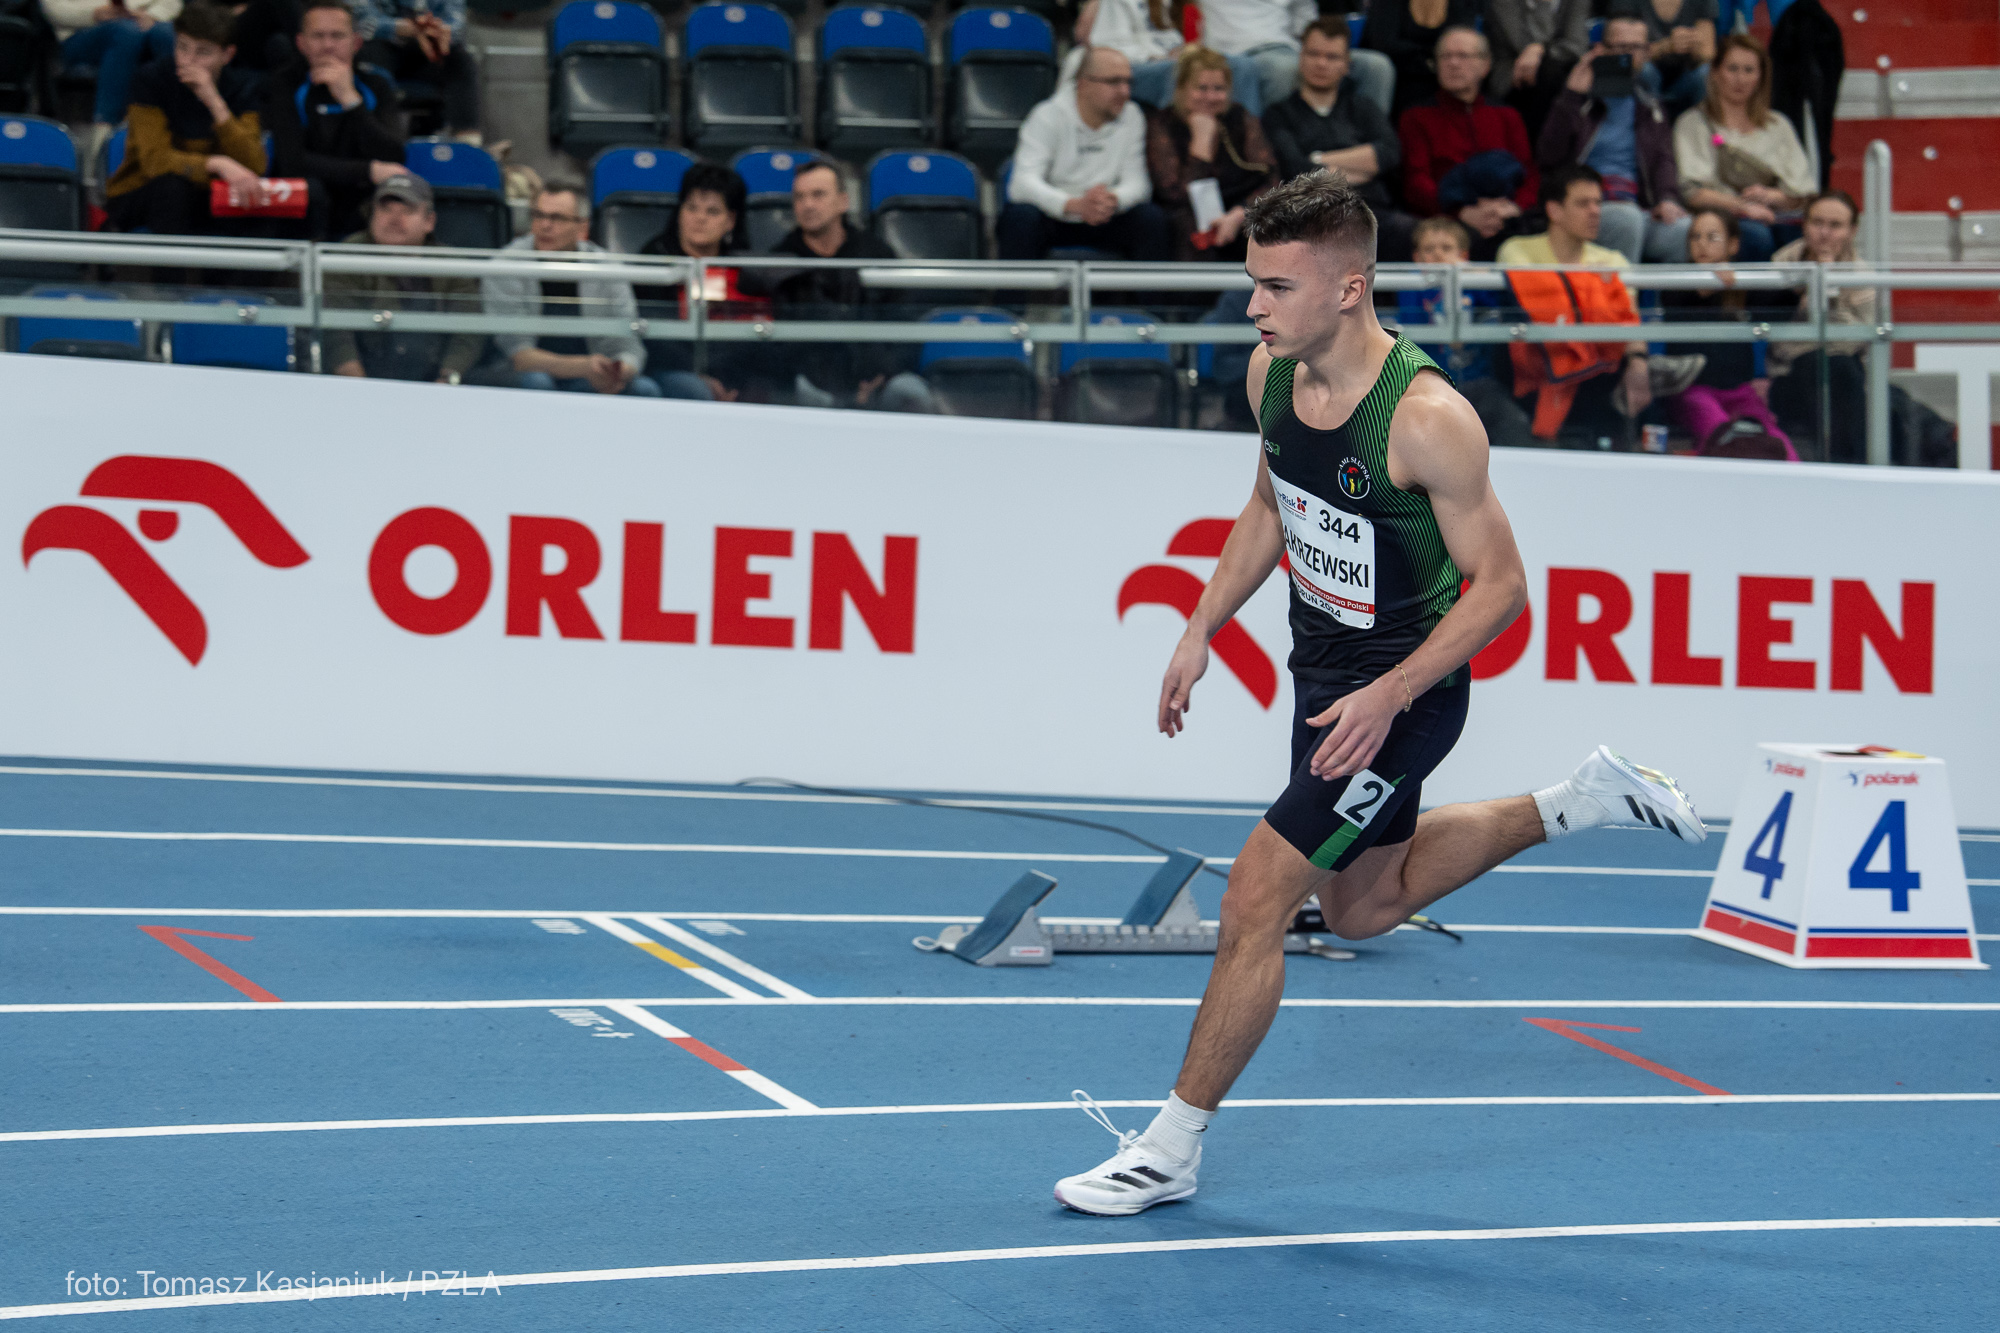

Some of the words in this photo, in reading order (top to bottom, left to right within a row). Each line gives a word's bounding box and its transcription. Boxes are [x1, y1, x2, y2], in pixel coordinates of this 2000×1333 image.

[1318, 509, 1361, 544] 344
[1283, 524, 1370, 589] AKRZEWSKI
[368, 506, 919, 654] ORLEN
[1319, 599, 1342, 618] 2024
[1347, 600, 1370, 612] Polski
[1863, 771, 1920, 788] polanik
[1344, 780, 1384, 825] 2
[1743, 790, 1794, 900] 4
[1847, 799, 1921, 912] 4
